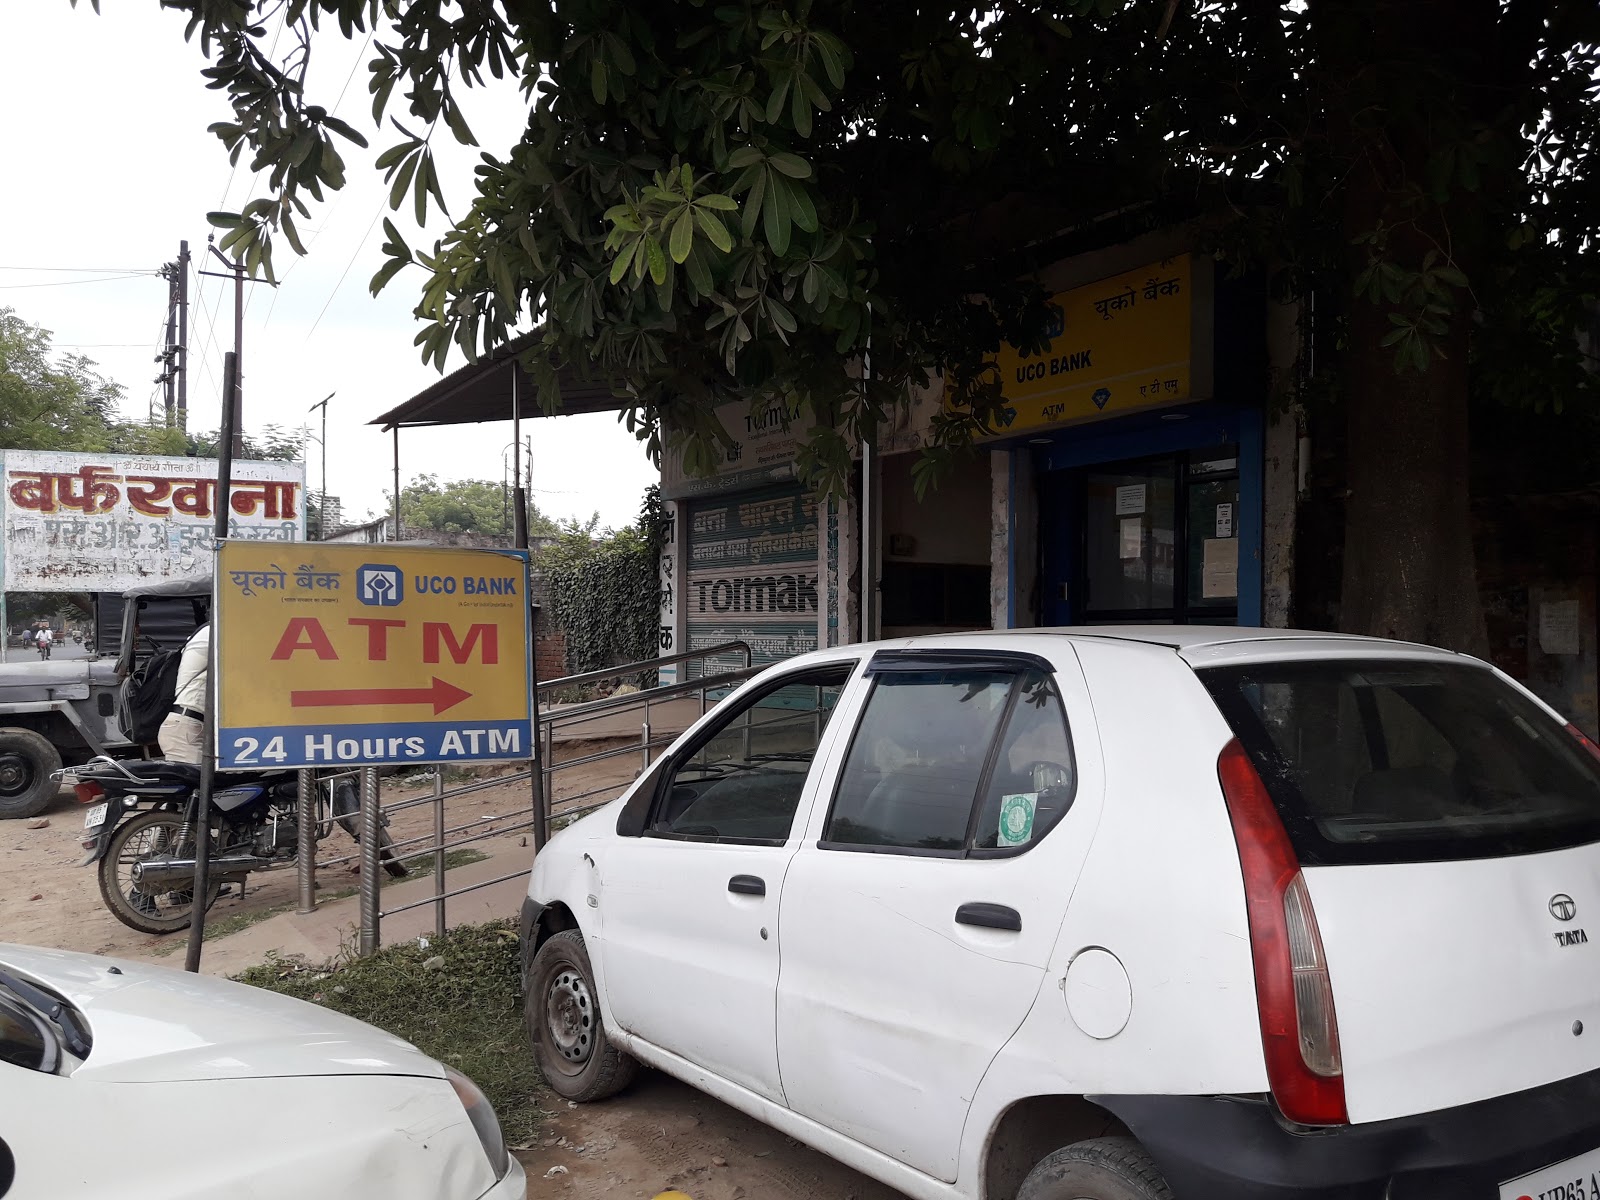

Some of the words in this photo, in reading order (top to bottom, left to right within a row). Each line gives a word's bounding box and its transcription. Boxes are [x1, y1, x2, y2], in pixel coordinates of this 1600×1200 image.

[1094, 286, 1137, 320] यूको
[1142, 277, 1181, 300] बैंक
[1016, 363, 1046, 384] UCO
[1050, 349, 1093, 376] BANK
[1041, 403, 1065, 417] ATM
[9, 465, 301, 519] बर्फखना
[229, 563, 287, 597] यूको
[293, 564, 341, 591] बैंक
[415, 575, 457, 594] UCO
[463, 576, 517, 595] BANK
[693, 573, 818, 613] Tormak
[270, 617, 498, 664] ATM
[234, 735, 287, 764] 24
[305, 733, 425, 760] Hours
[439, 728, 520, 756] ATM
[1553, 929, 1588, 946] TATA
[1538, 1177, 1585, 1200] P65
